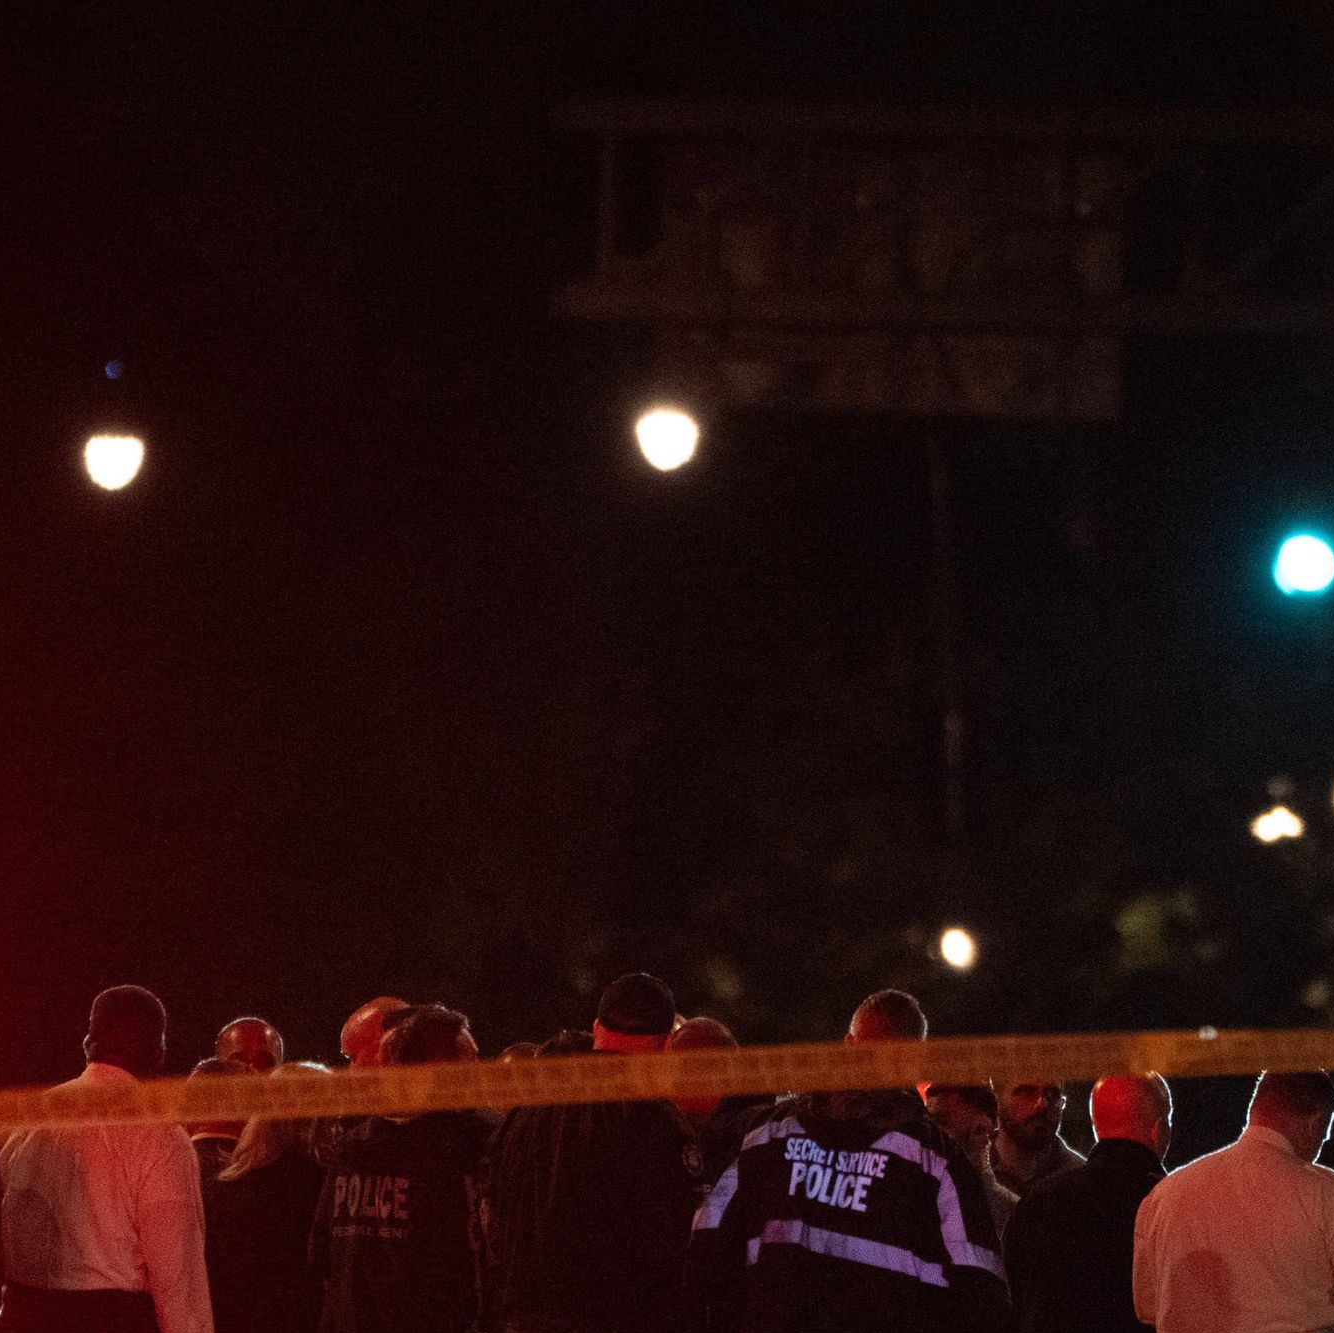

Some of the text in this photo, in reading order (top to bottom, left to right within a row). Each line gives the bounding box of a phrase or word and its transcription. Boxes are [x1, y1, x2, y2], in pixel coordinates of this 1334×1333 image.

[788, 1162, 872, 1212] POLICE
[836, 1150, 889, 1179] SERVICE
[333, 1173, 410, 1220] POLICE
